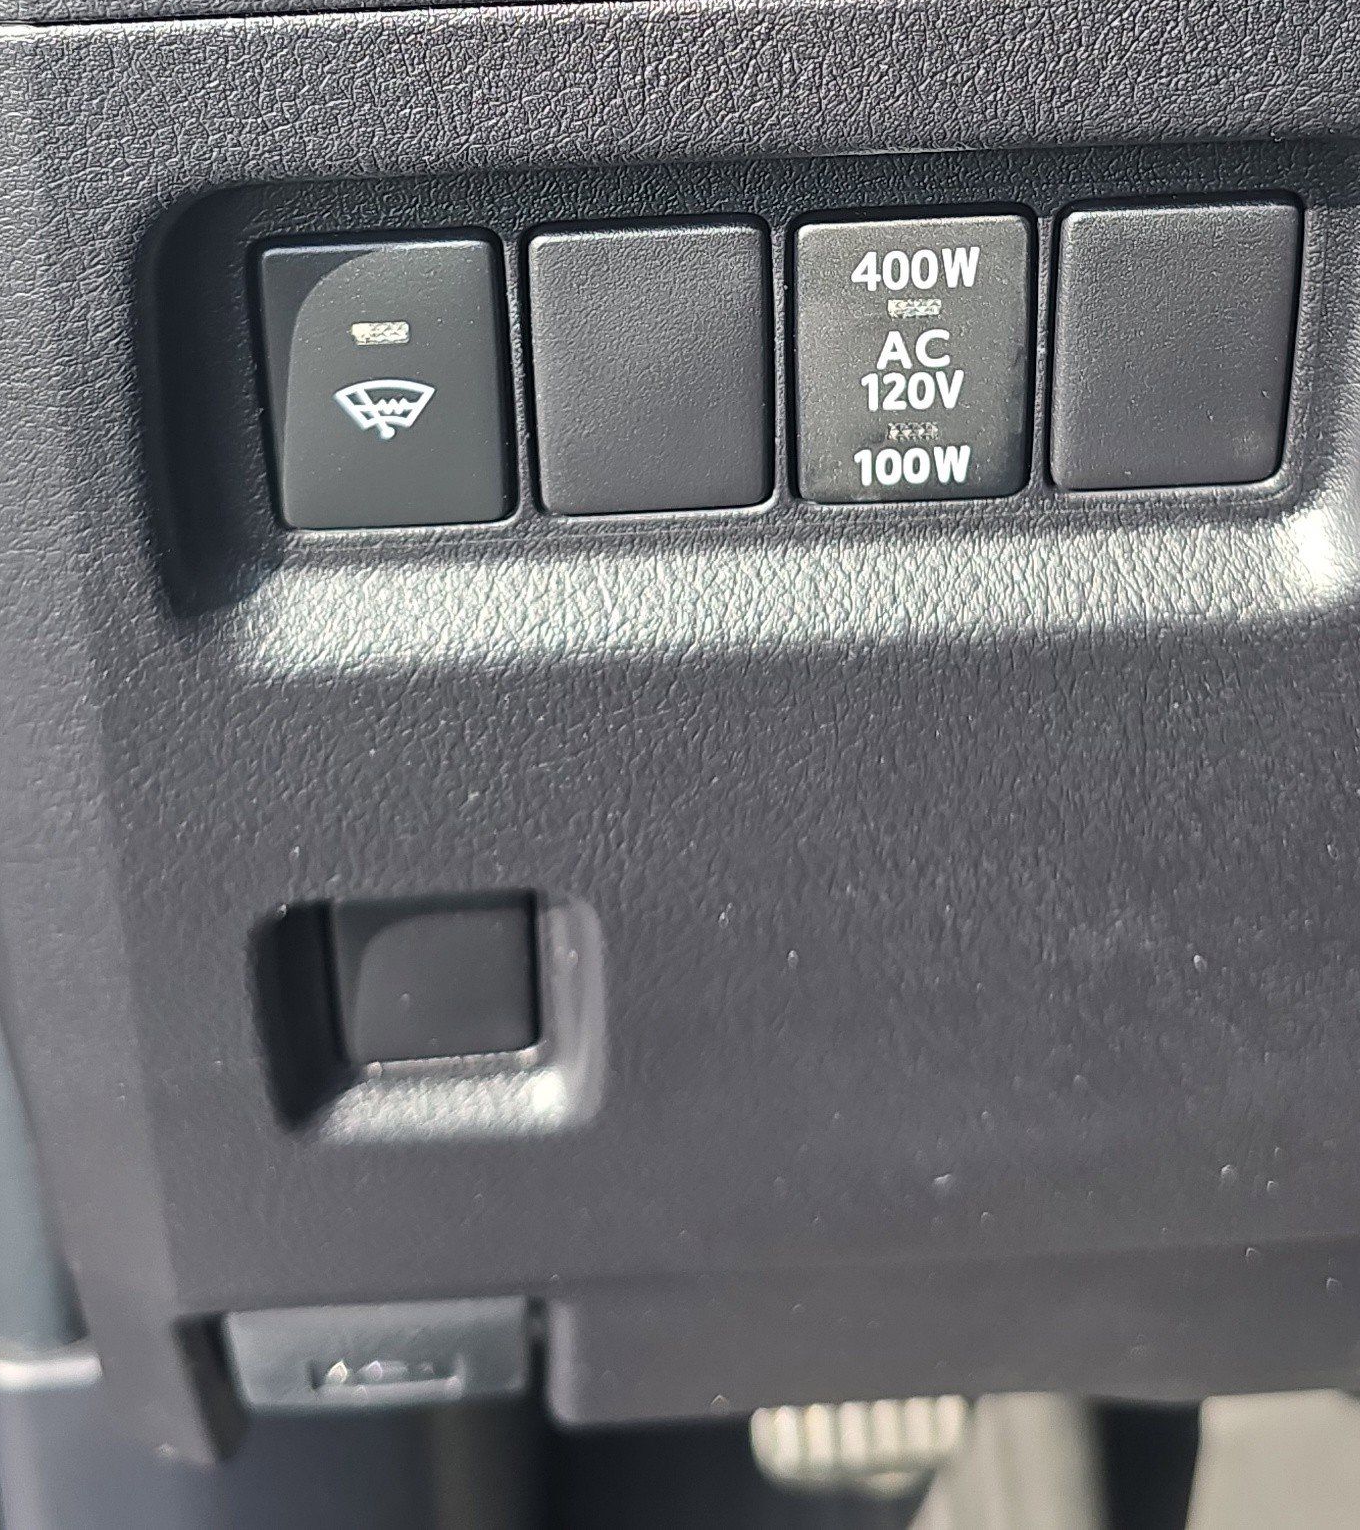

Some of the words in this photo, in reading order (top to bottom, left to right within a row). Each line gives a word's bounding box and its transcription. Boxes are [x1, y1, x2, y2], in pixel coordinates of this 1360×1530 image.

[850, 246, 981, 292] 400W
[876, 328, 951, 370] AC
[860, 369, 965, 412] 120V
[853, 444, 971, 487] 100W
